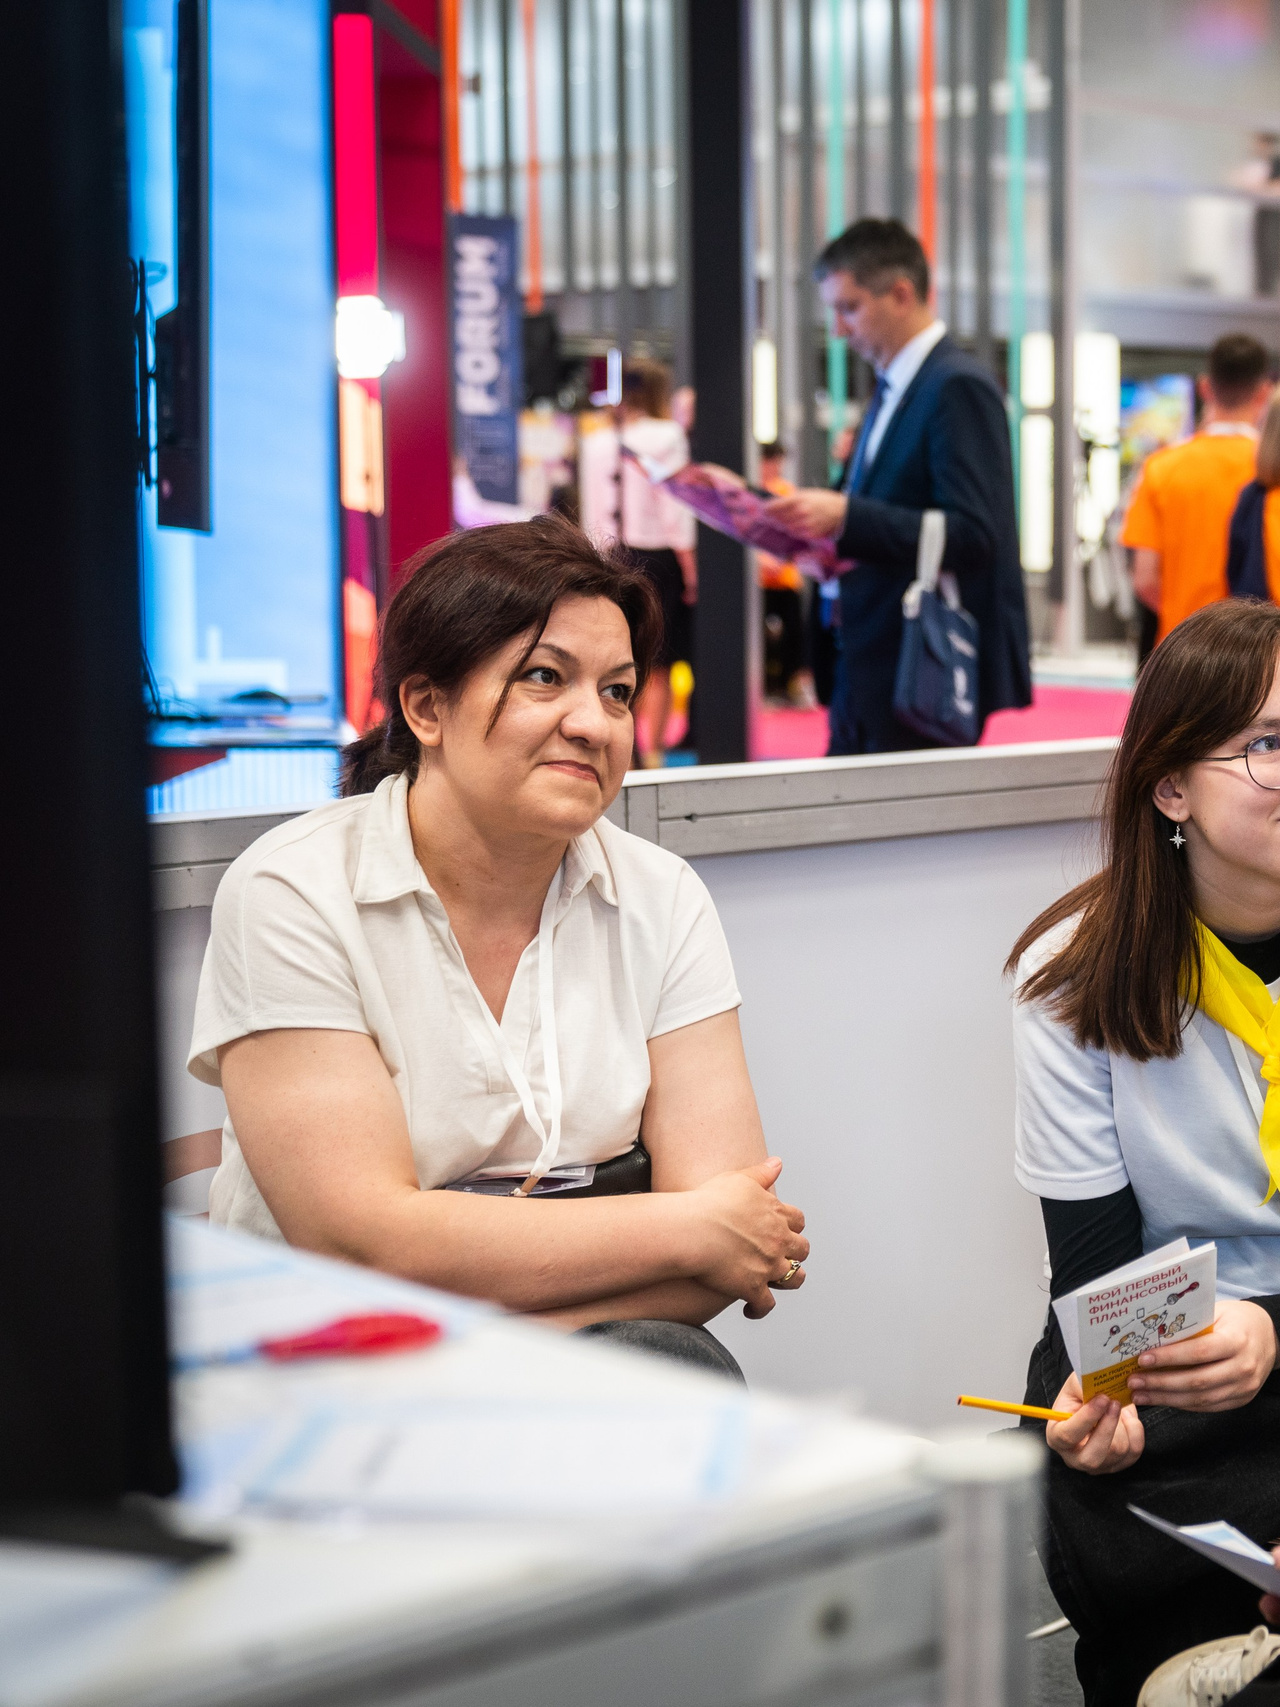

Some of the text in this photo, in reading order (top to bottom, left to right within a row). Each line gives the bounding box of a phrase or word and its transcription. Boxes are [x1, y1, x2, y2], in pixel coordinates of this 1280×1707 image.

[454, 233, 500, 416] FORUM
[1088, 1264, 1182, 1304] МОЙ ПЕРВЫЙ
[1088, 1272, 1189, 1315] ФИНАНСОВЫЙ
[1089, 1307, 1129, 1326] ПЛАН
[1093, 1372, 1108, 1382] КАК
